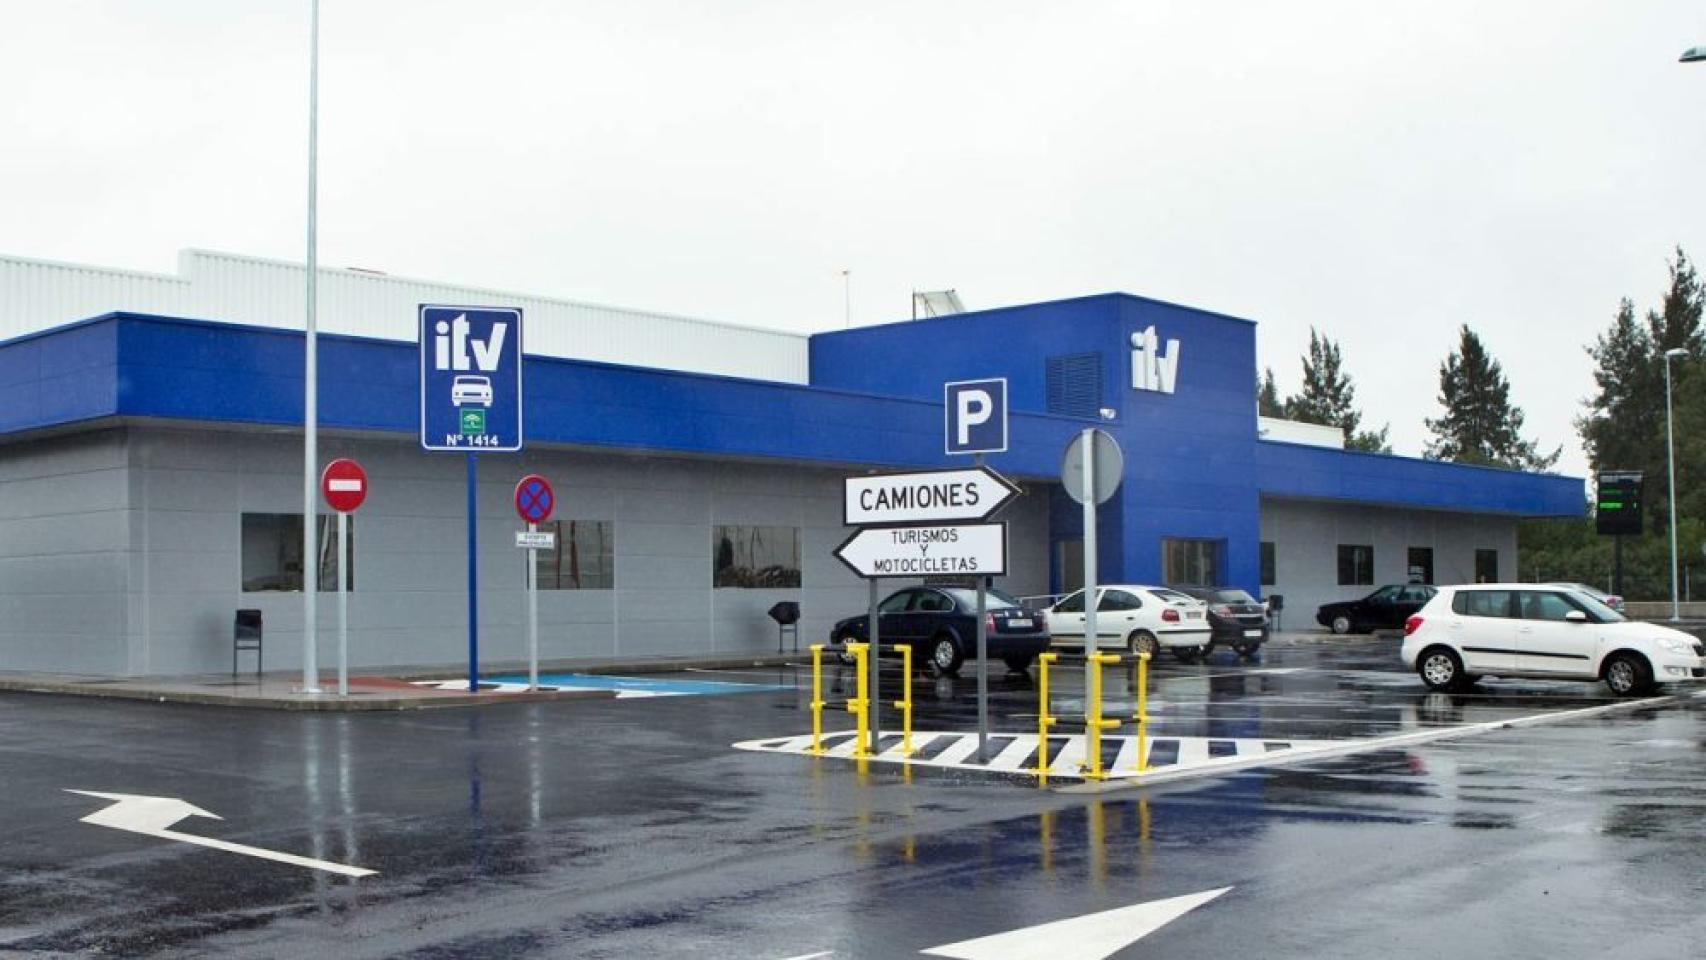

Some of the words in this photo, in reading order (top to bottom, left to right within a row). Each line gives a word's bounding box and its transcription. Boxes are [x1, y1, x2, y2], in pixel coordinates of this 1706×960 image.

[435, 312, 507, 371] itv
[1130, 325, 1180, 394] itv
[957, 389, 993, 444] P
[467, 435, 499, 446] 1414
[860, 482, 980, 511] CAMIONES
[892, 528, 958, 545] TURISMOS
[919, 544, 929, 557] Y
[874, 557, 978, 572] MOTOCICLETAS
